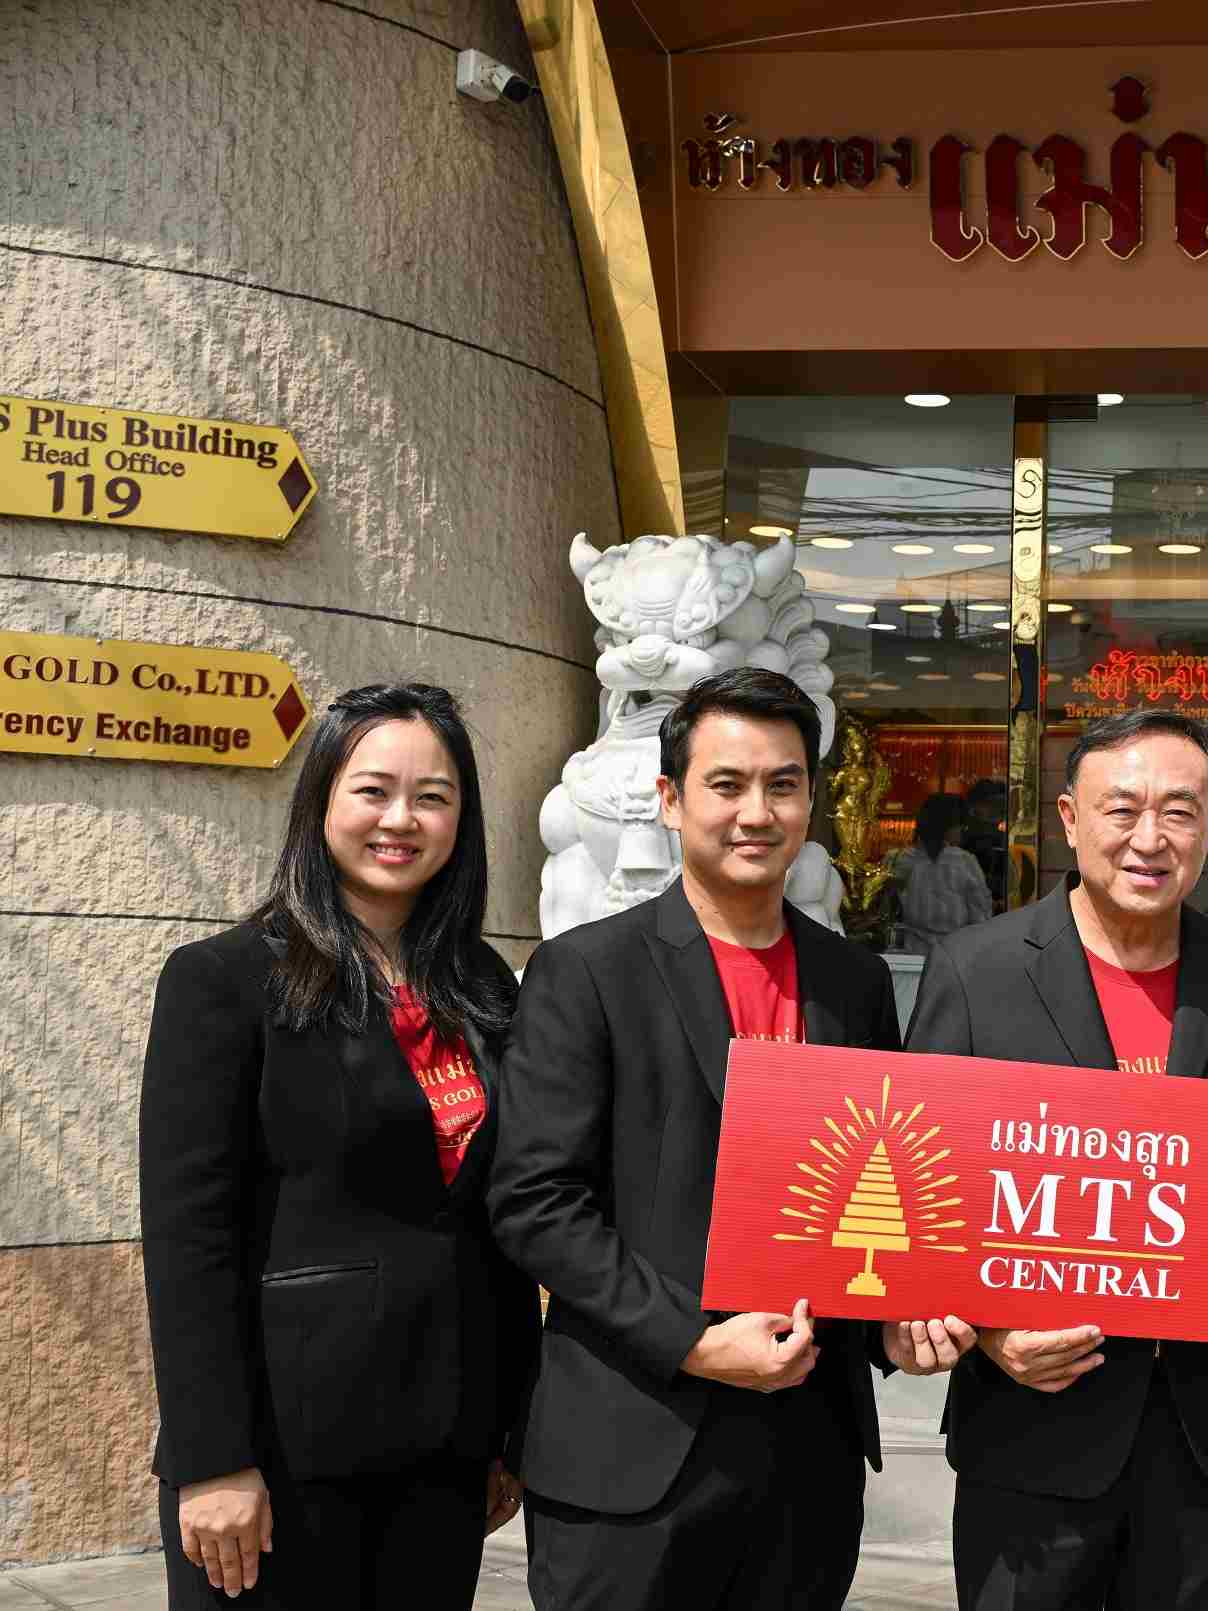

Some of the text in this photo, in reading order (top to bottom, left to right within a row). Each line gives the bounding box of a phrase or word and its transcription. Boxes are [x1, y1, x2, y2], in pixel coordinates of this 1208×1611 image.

[680, 111, 914, 191] ห้างทอง
[21, 440, 186, 477] Head Office
[24, 406, 108, 442] Plus
[121, 416, 279, 469] Building
[46, 470, 142, 519] 119
[3, 654, 120, 686] GOLD
[0, 711, 251, 752] ency Exchange
[990, 1102, 1191, 1177] แม่ทองสุก
[985, 1168, 1187, 1248] MTS
[979, 1256, 1182, 1301] CENTRAL
